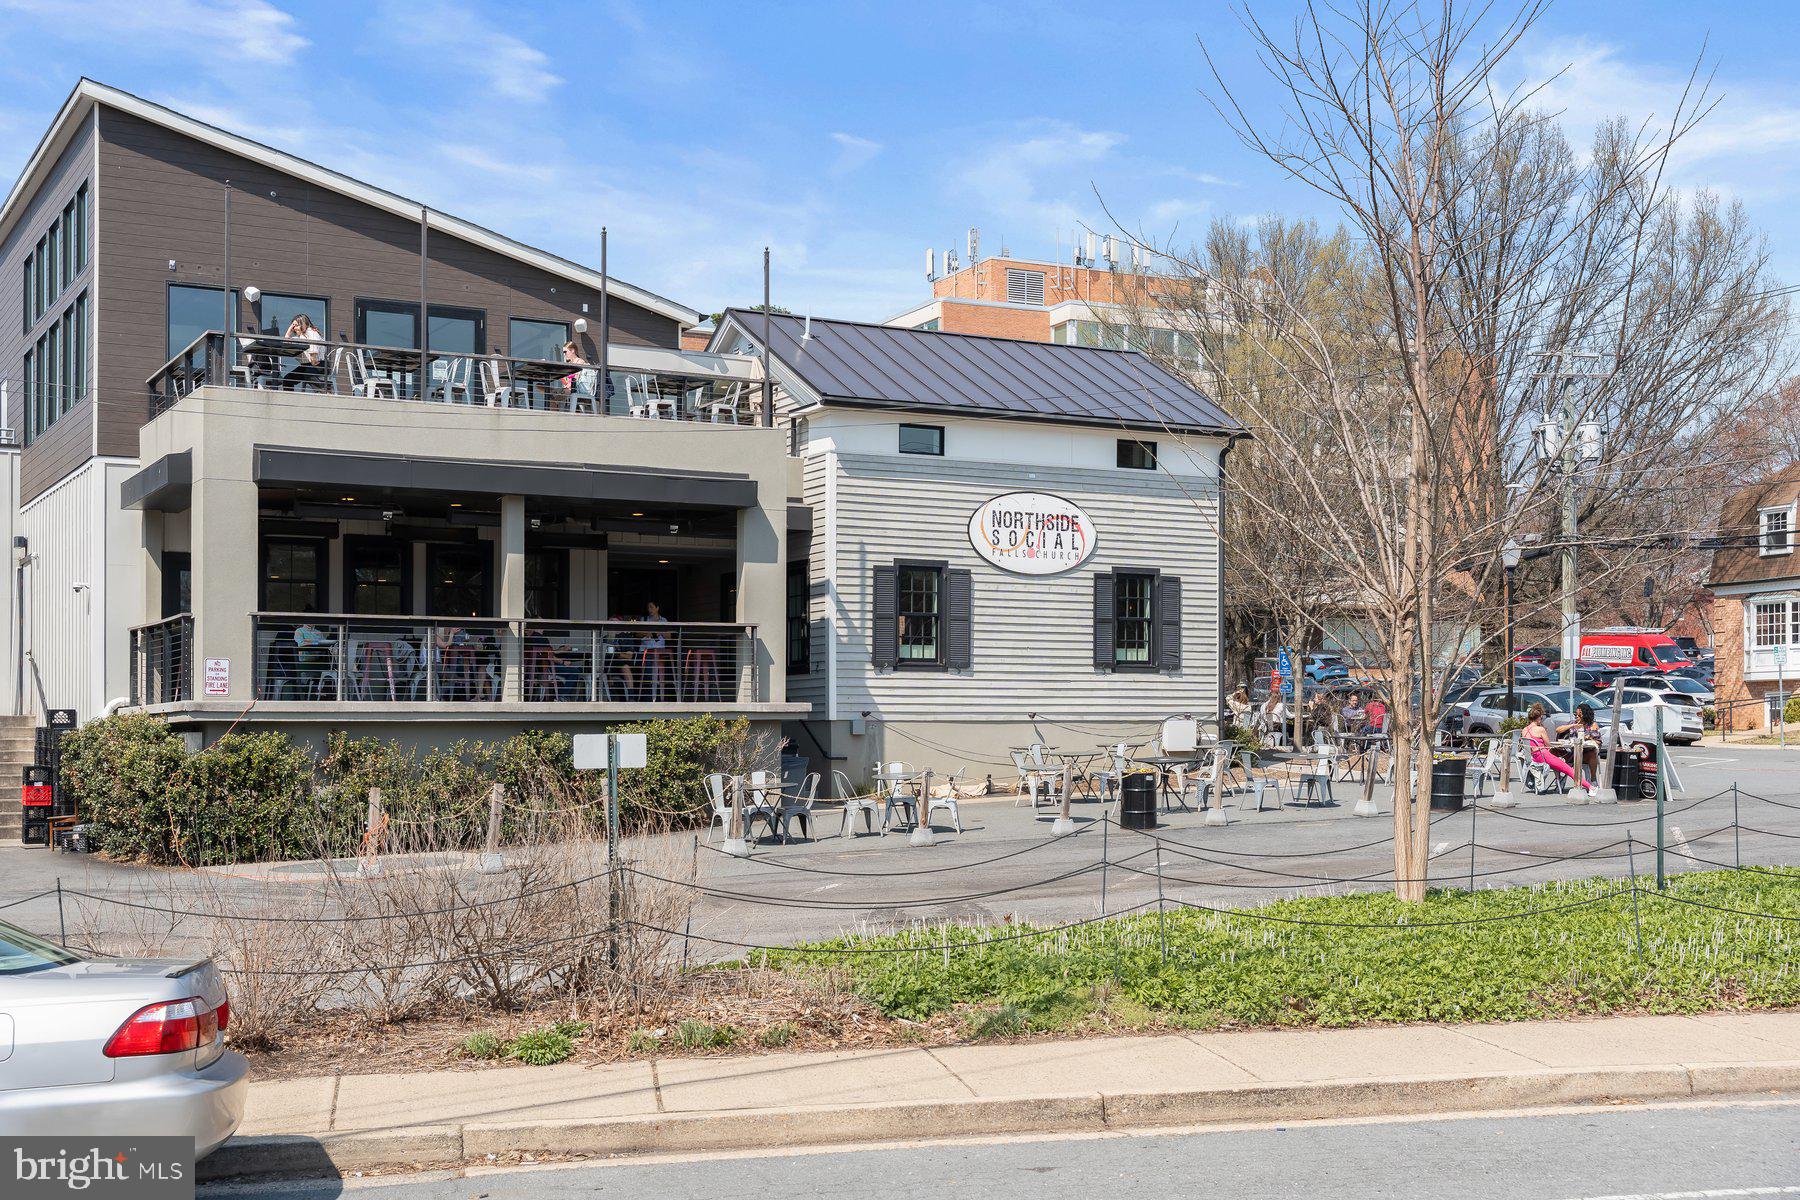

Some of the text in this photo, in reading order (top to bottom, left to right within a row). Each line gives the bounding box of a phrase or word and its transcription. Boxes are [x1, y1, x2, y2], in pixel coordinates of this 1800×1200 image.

[992, 510, 1079, 532] NORTHSIDE
[992, 530, 1079, 550] SOCIAL
[992, 548, 1080, 560] FALLS CHURCH
